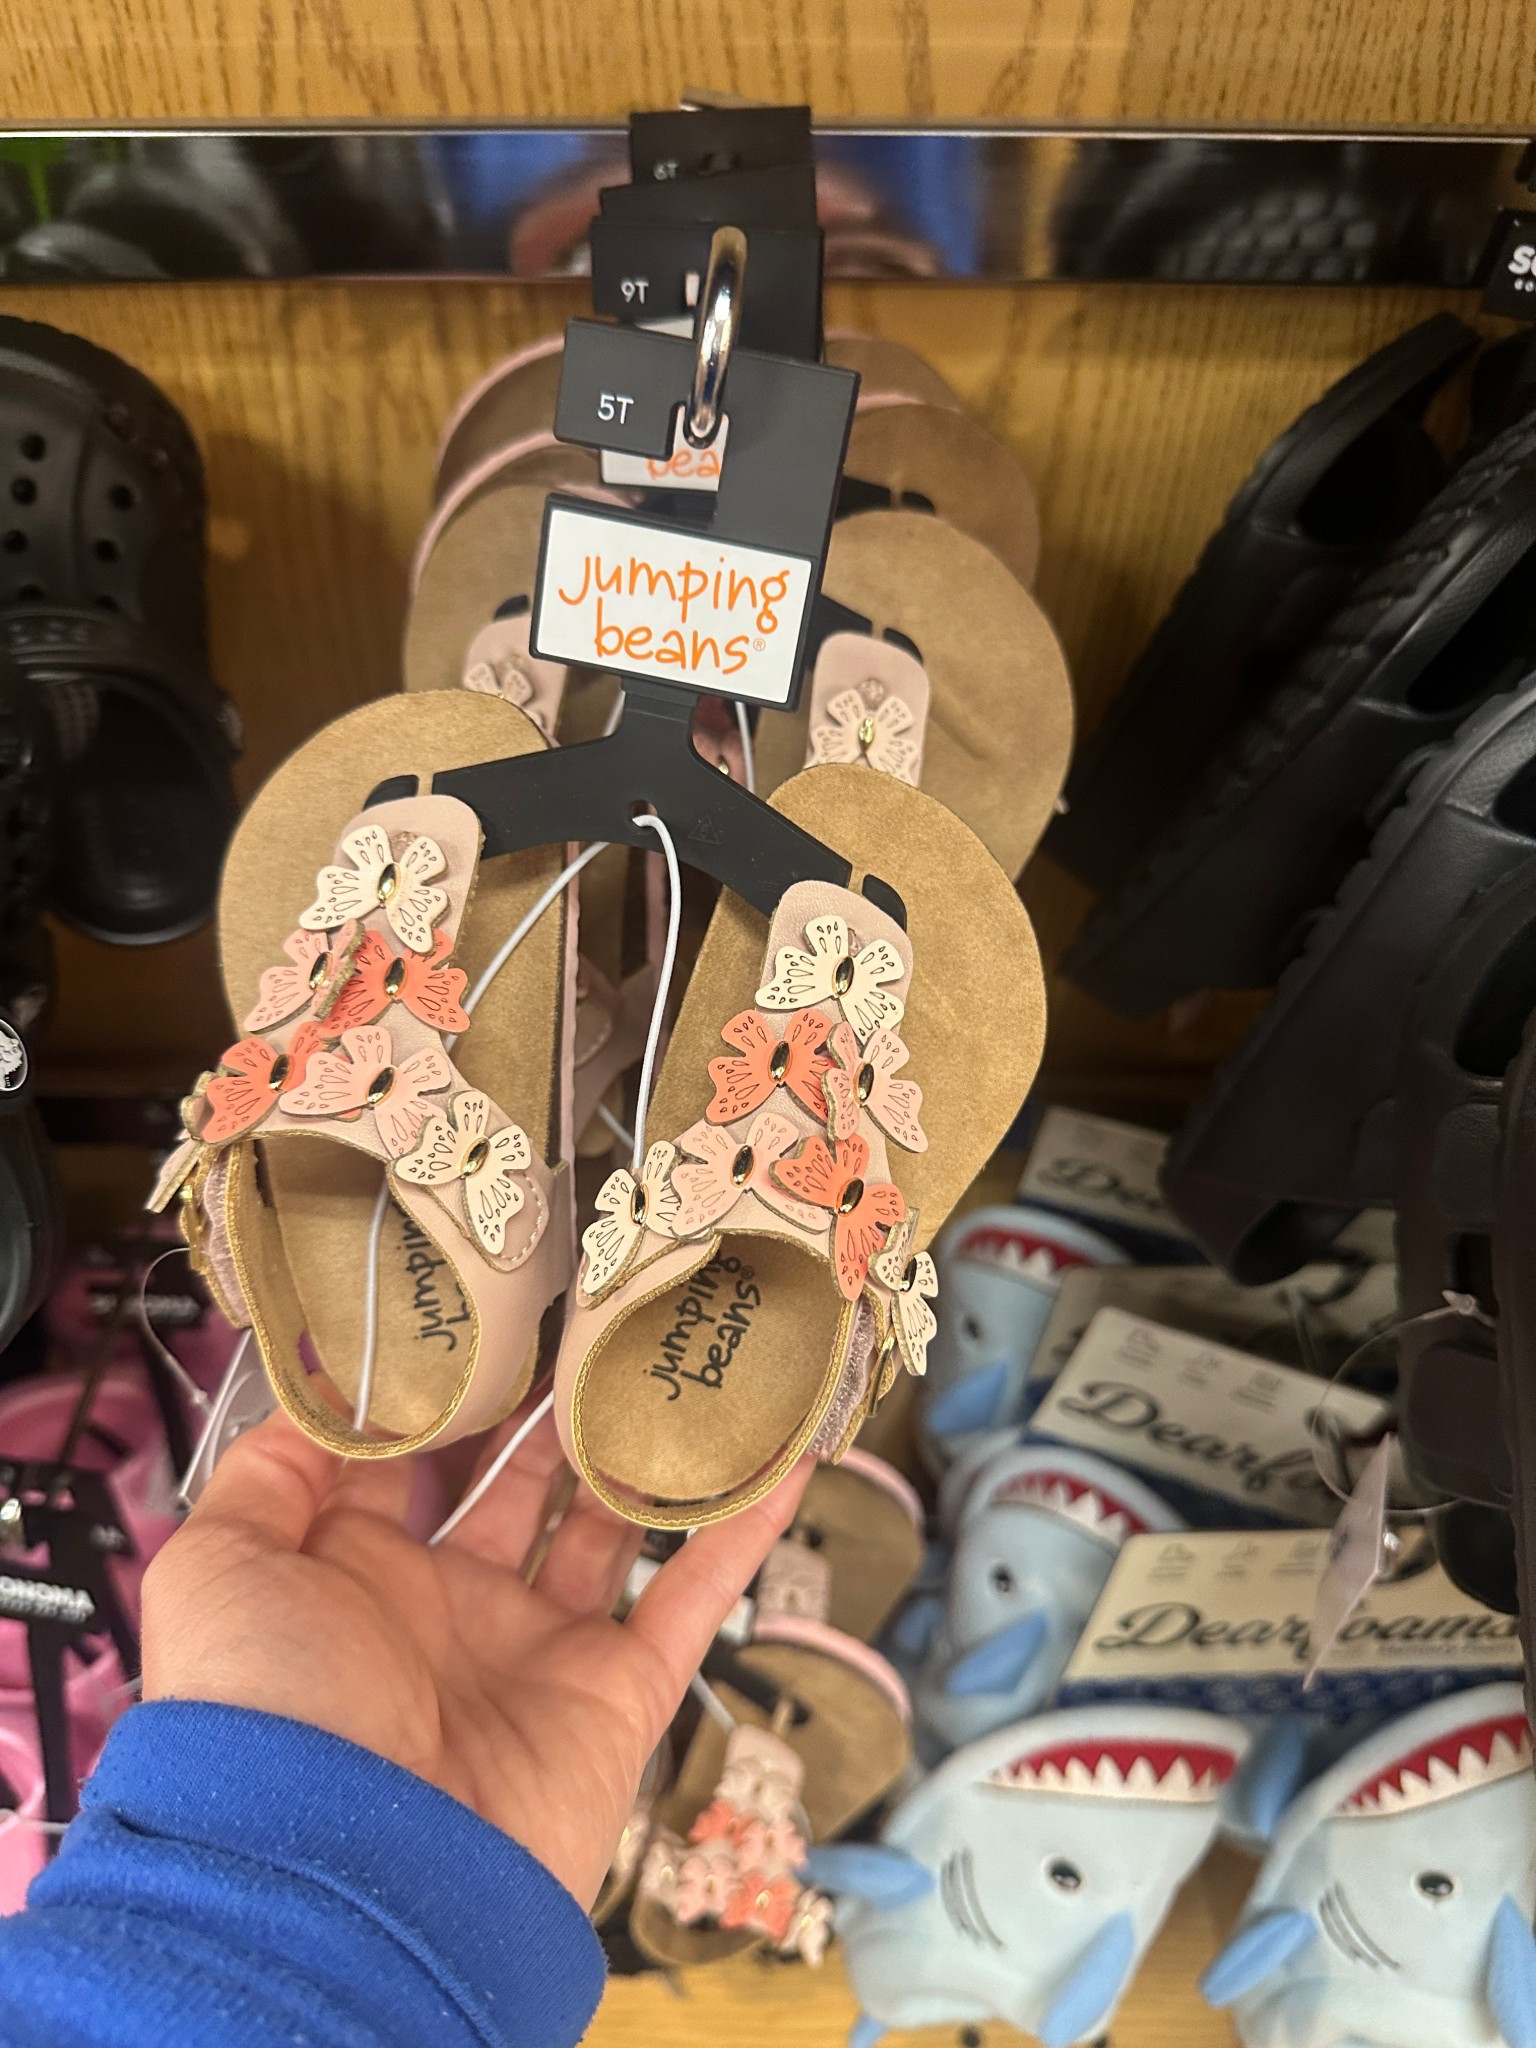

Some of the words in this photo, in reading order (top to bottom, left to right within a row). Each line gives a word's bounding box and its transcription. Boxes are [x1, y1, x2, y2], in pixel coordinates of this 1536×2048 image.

[620, 278, 649, 304] 9T
[597, 393, 634, 425] 5T
[558, 555, 791, 635] jumping
